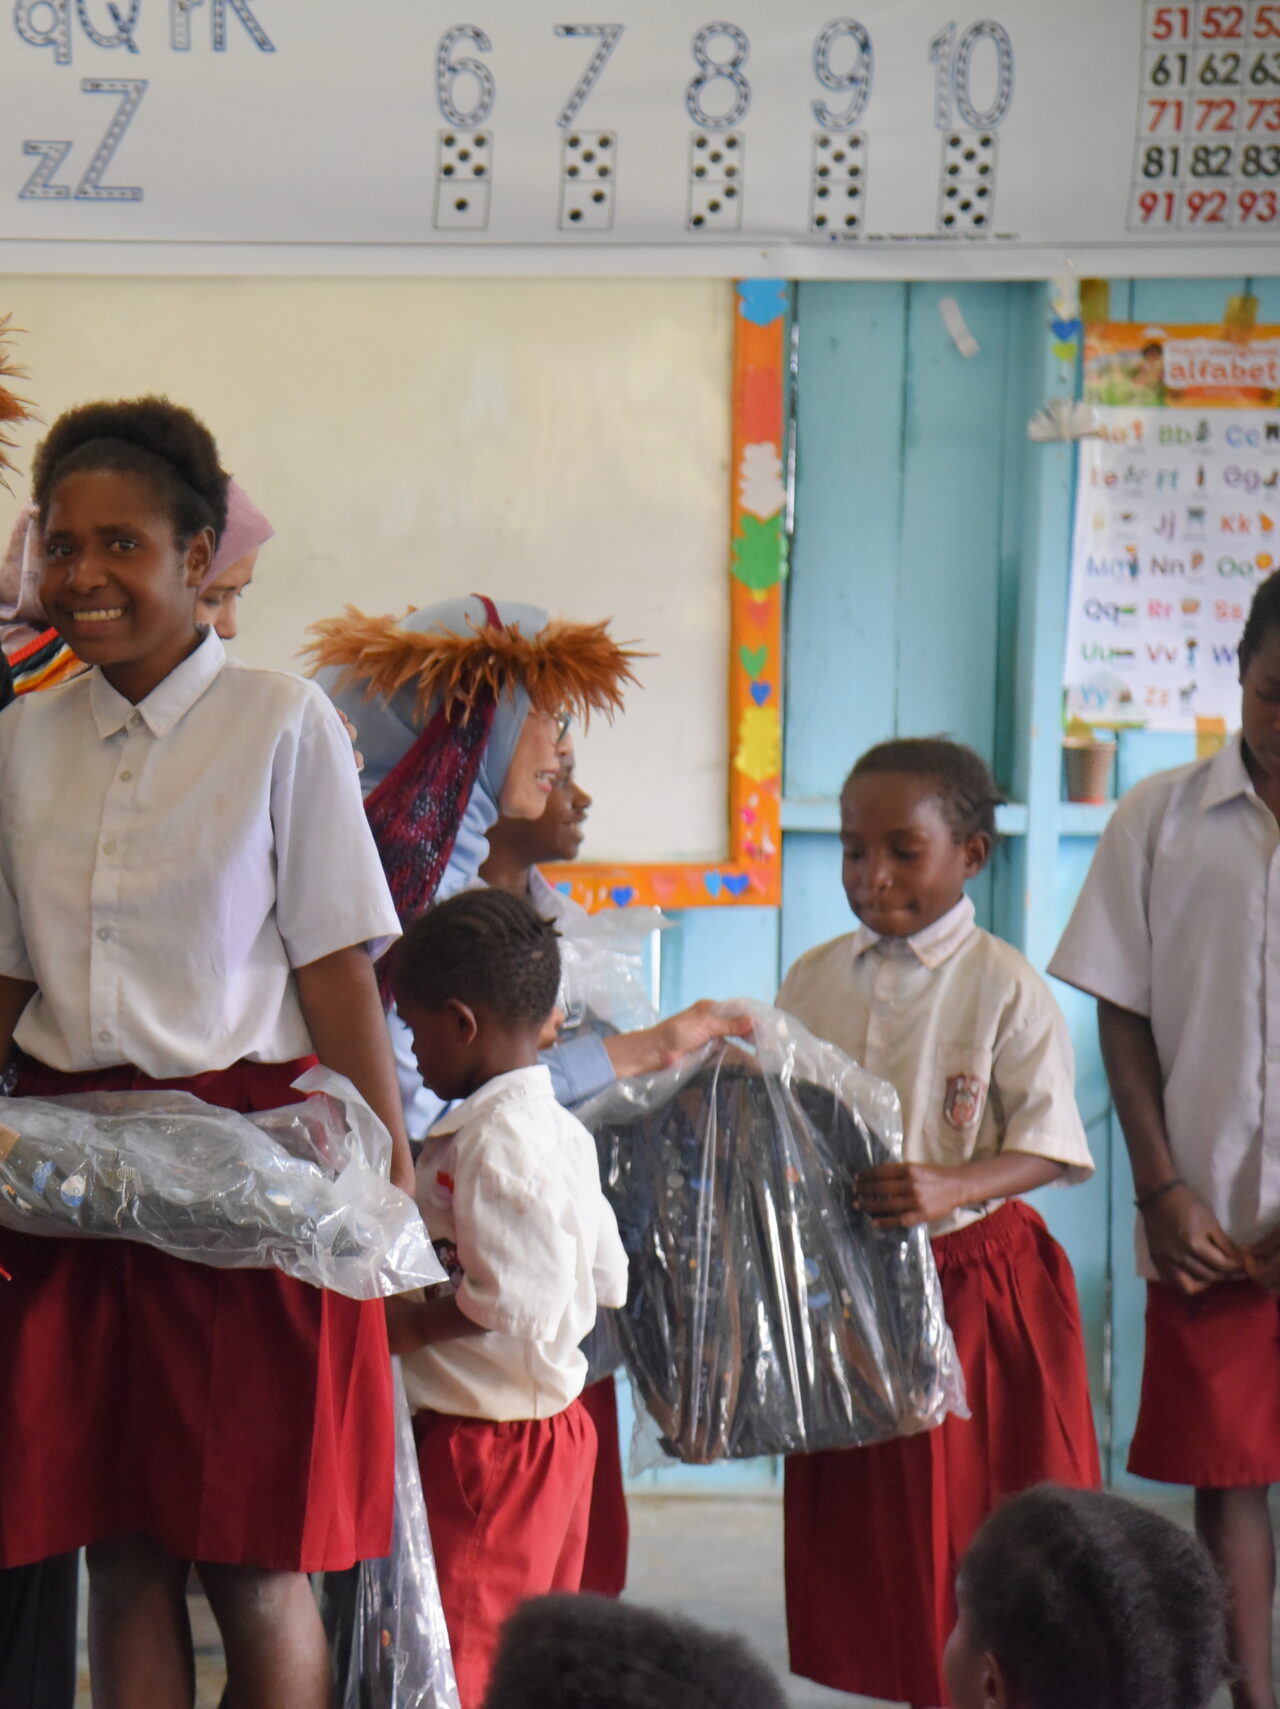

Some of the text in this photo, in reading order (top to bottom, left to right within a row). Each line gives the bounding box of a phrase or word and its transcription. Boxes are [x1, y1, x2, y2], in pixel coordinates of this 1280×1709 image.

[1152, 6, 1189, 40] 51
[1200, 6, 1243, 39] 52
[434, 17, 1015, 132] 6 7 8 9 10
[1150, 53, 1187, 86] 61
[1198, 52, 1241, 86] 62
[1147, 98, 1280, 132] 71 72 73
[19, 78, 148, 200] zZ
[1142, 144, 1280, 178] 81 82 83
[1138, 189, 1277, 224] 91 92 93
[1169, 359, 1278, 382] alfabet
[1220, 512, 1251, 534] Kk
[1150, 555, 1185, 576] Nn
[1212, 645, 1238, 665] W
